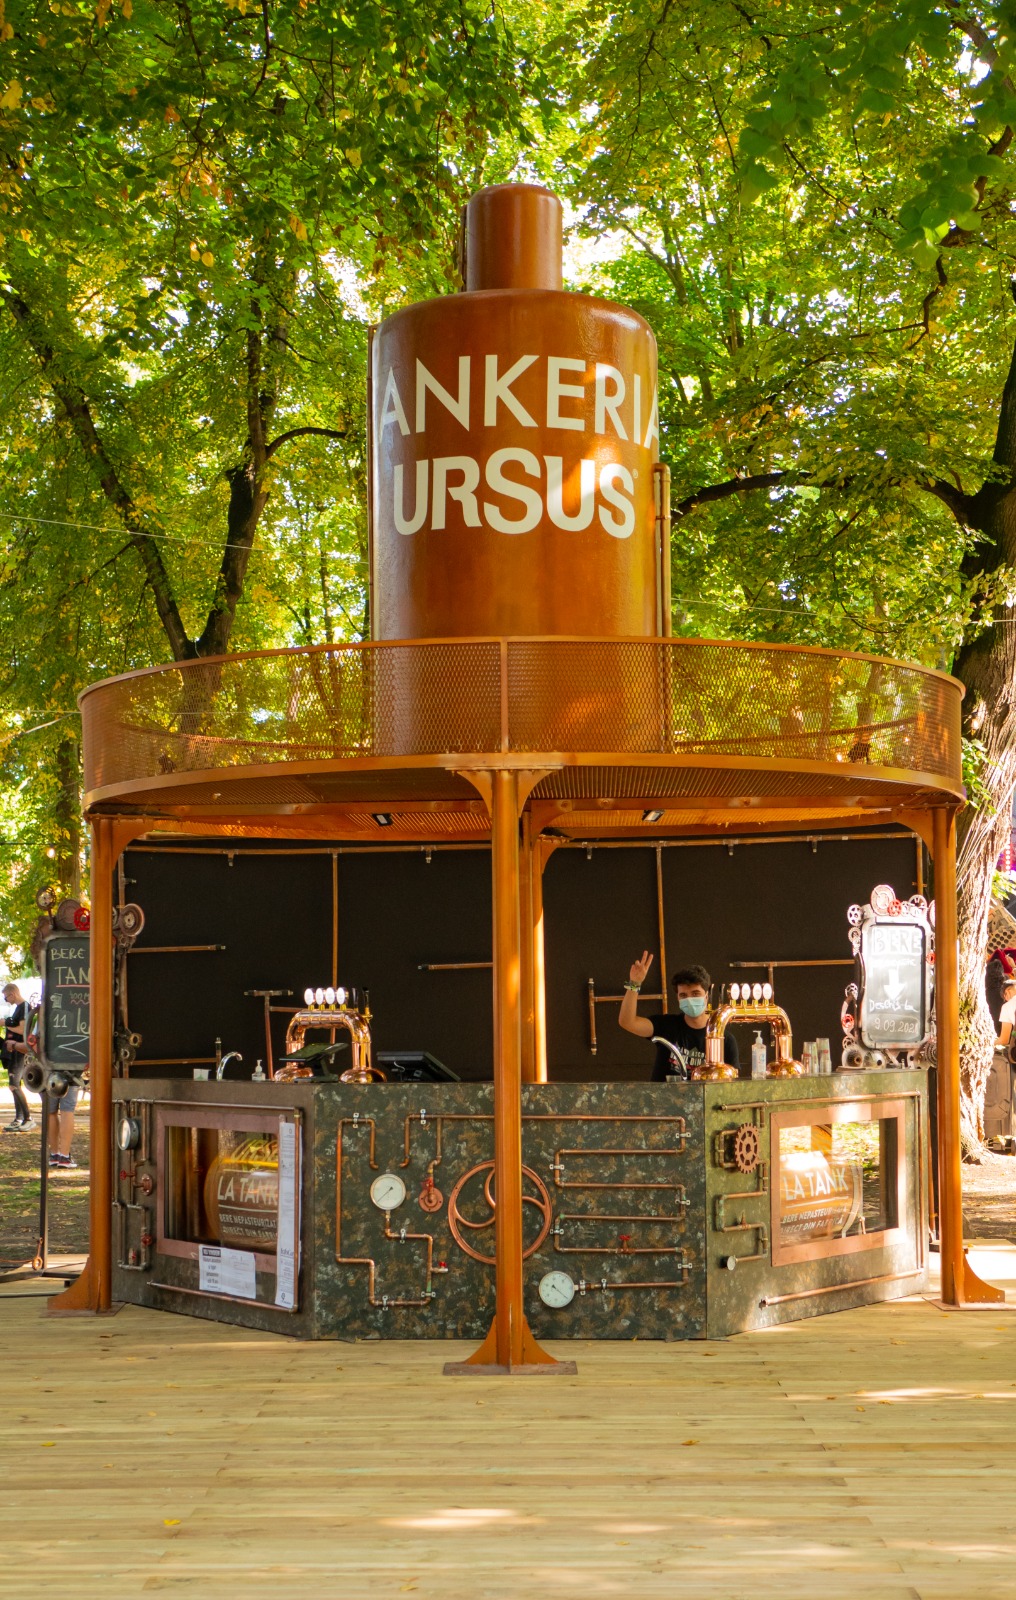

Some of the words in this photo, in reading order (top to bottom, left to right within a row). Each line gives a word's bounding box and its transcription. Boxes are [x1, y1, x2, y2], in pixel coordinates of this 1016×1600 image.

[393, 447, 636, 539] URSUS
[873, 928, 921, 953] BERE
[50, 948, 85, 960] BERE
[52, 1014, 68, 1028] 11
[217, 1175, 235, 1202] LA
[783, 1174, 806, 1201] LA
[805, 1167, 849, 1197] TANK
